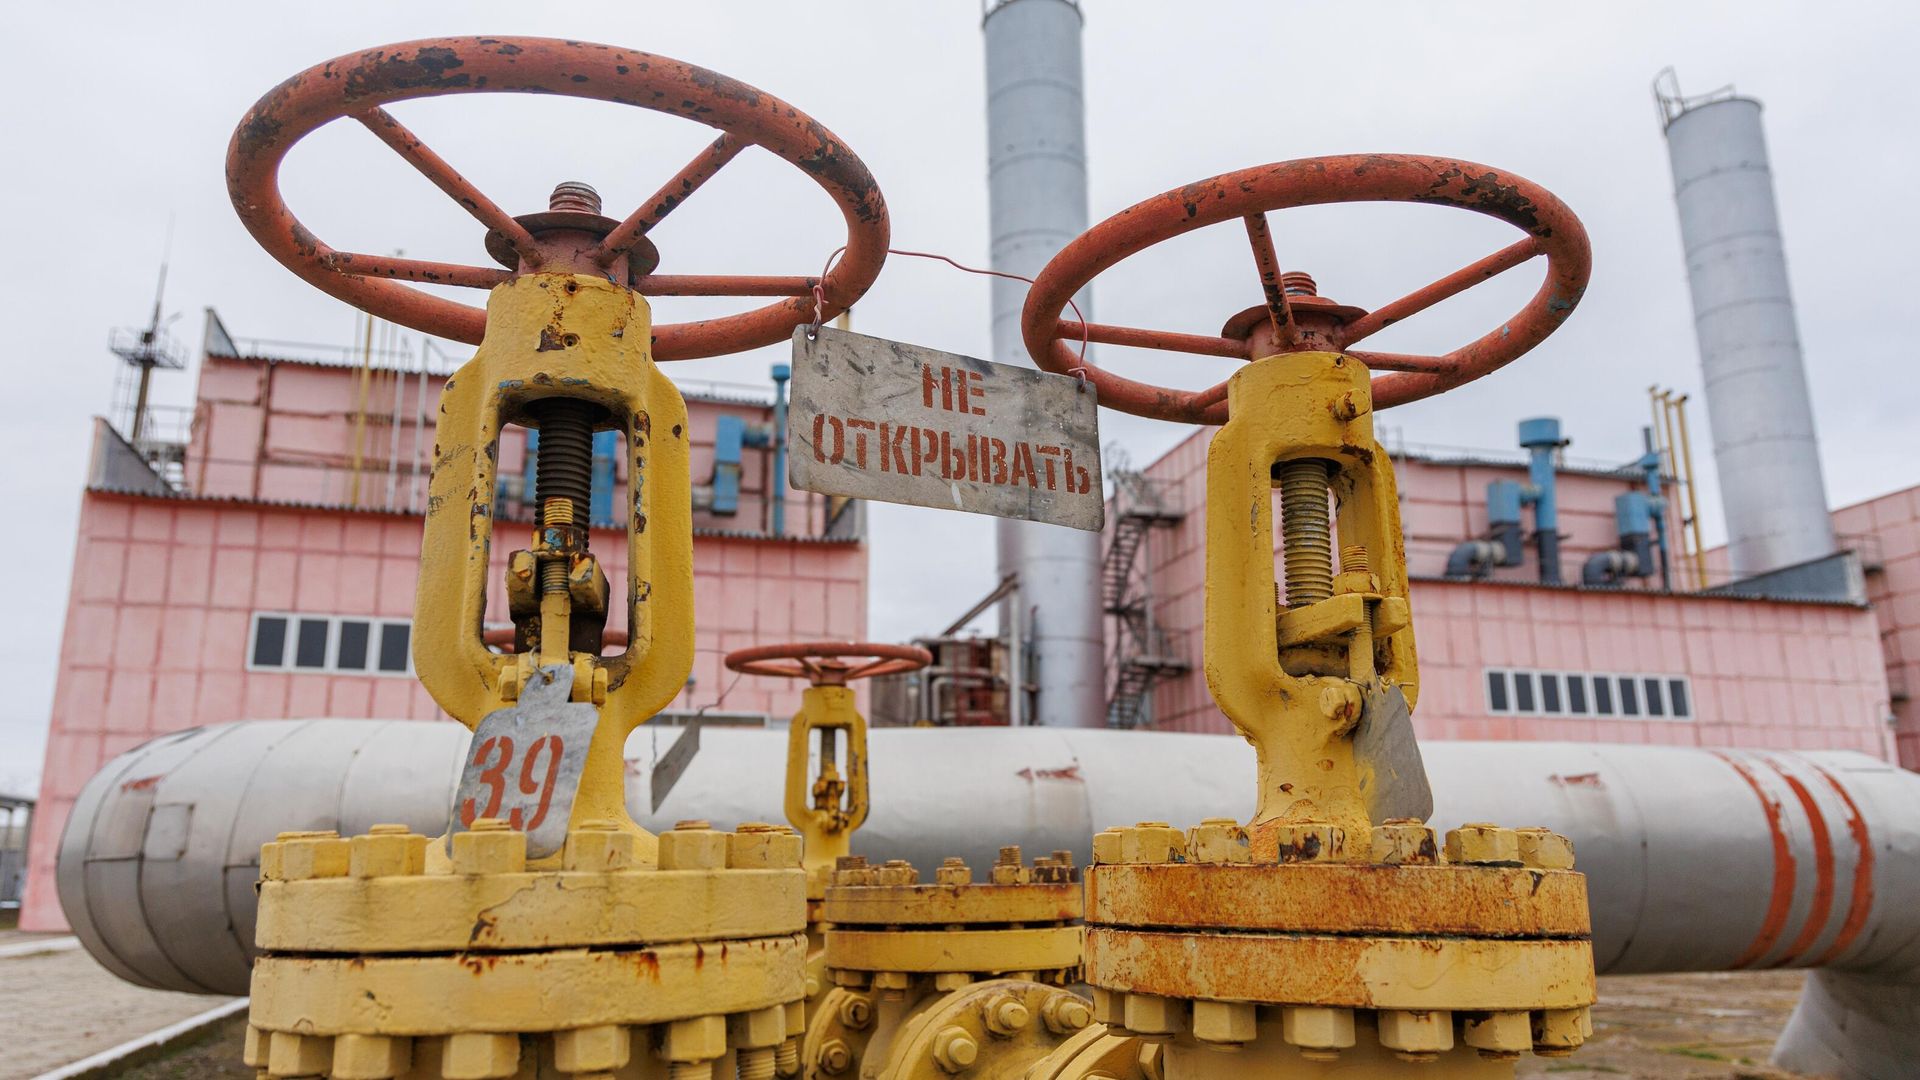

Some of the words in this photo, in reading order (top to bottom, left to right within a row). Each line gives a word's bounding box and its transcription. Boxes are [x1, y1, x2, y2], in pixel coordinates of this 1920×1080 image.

[922, 363, 986, 416] НЕ
[813, 413, 1090, 494] ОТКРЫВАТЬ
[460, 735, 563, 831] 39
